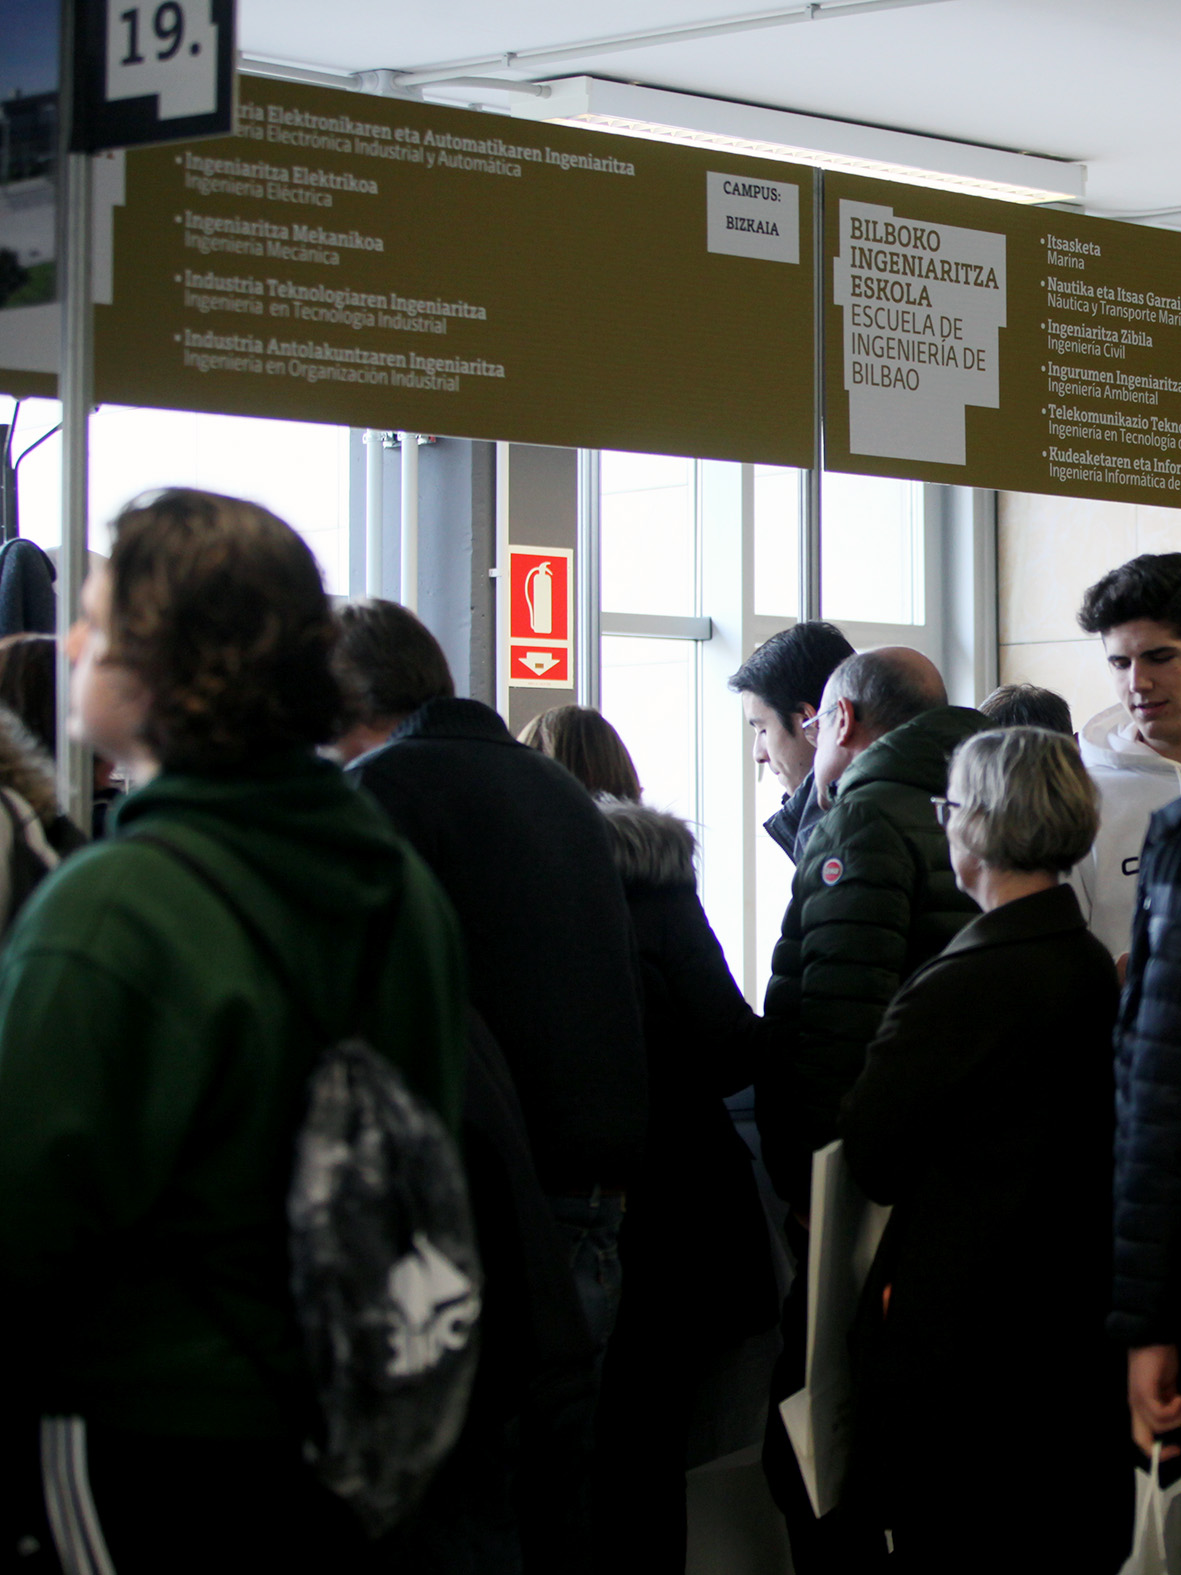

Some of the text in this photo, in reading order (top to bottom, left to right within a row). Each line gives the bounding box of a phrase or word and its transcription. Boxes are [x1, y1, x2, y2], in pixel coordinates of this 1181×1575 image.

[119, 1, 202, 67] 19.
[267, 104, 392, 140] Elektronikaren
[394, 126, 420, 144] eta
[423, 129, 542, 162] Automatikaren
[545, 147, 636, 176] Ingeniaritza
[184, 151, 379, 195] Ingeniaritza Elektrikoa
[354, 138, 424, 163] Industrial
[426, 152, 436, 169] y
[437, 150, 522, 178] Automática
[723, 181, 782, 202] CAMPUS:
[184, 209, 385, 252] Ingeniaritza Mekanikoa
[726, 215, 780, 236] BIZKAIA
[850, 217, 941, 252] BILBOKO
[1047, 234, 1101, 256] Itsasketa
[1047, 250, 1085, 270] Marina
[850, 245, 1000, 290] INGENIARITZA
[184, 269, 487, 321] Industria Teknologiaren Ingeniaritza
[850, 274, 933, 308] ESKOLA
[1047, 276, 1095, 298] Nautika
[1096, 286, 1115, 301] eta
[1117, 287, 1144, 305] Itsas
[269, 302, 290, 318] en
[377, 311, 447, 335] Industrial
[851, 303, 963, 341] ESCUELA DE
[1047, 293, 1090, 312] Náutica
[1091, 302, 1098, 317] y
[1099, 300, 1157, 323] Transporte
[1047, 319, 1153, 348] Ingeniaritza Zibila
[1048, 335, 1126, 359] Ingeniería Civil
[184, 328, 505, 378] Industria Antolakuntzaren Ingeniaritza
[852, 332, 986, 372] INGENIERÍA DE
[265, 359, 286, 376] en
[391, 369, 460, 392] Industrial
[852, 361, 920, 391] BILBAO
[1048, 361, 1114, 383] Ingurumen
[1048, 377, 1159, 405] Ingeniería Ambiental
[1048, 403, 1149, 430] Telekomunikazio
[1048, 420, 1101, 440] Ingeniería
[1104, 429, 1118, 442] en
[1119, 428, 1177, 451] Tecnología
[1049, 446, 1131, 470] Kudeaketaren
[1133, 457, 1152, 472] eta
[1049, 463, 1103, 482] Ingeniería
[1104, 468, 1166, 489] Informática
[1167, 475, 1181, 490] de
